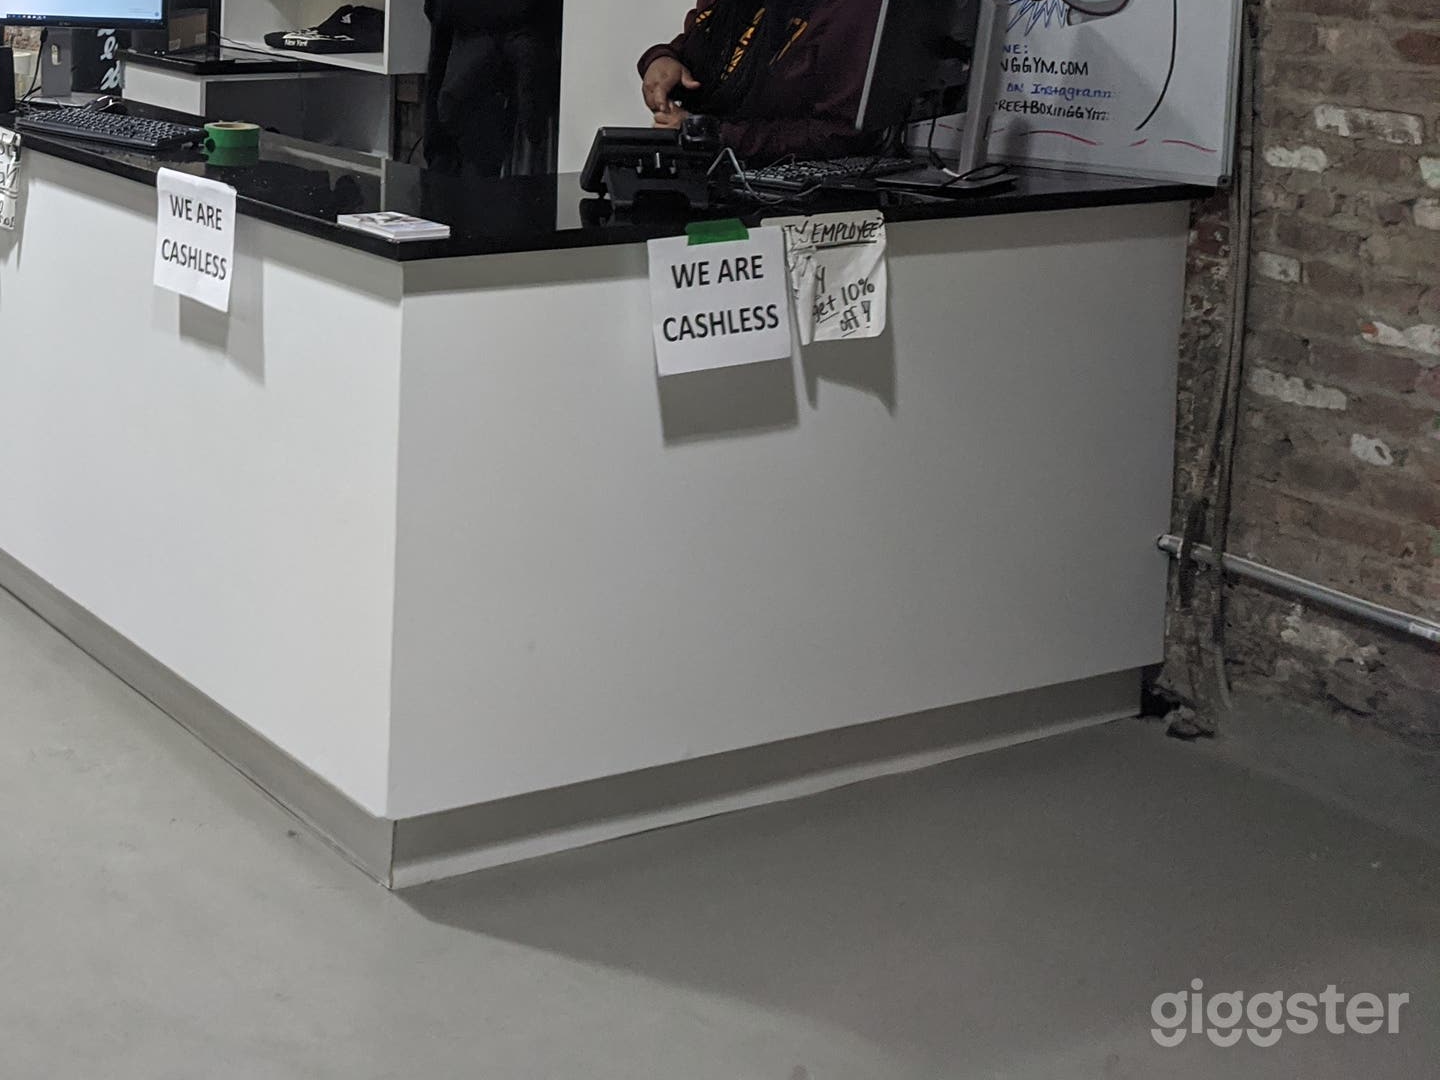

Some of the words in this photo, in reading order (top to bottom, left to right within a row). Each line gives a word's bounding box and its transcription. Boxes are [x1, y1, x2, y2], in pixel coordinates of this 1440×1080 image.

[170, 194, 192, 221] WE
[196, 203, 222, 231] ARE
[162, 239, 227, 280] CASHLESS
[671, 260, 710, 289] WE
[717, 255, 764, 284] ARE
[841, 278, 875, 305] 10%
[663, 304, 779, 342] CASHLESS
